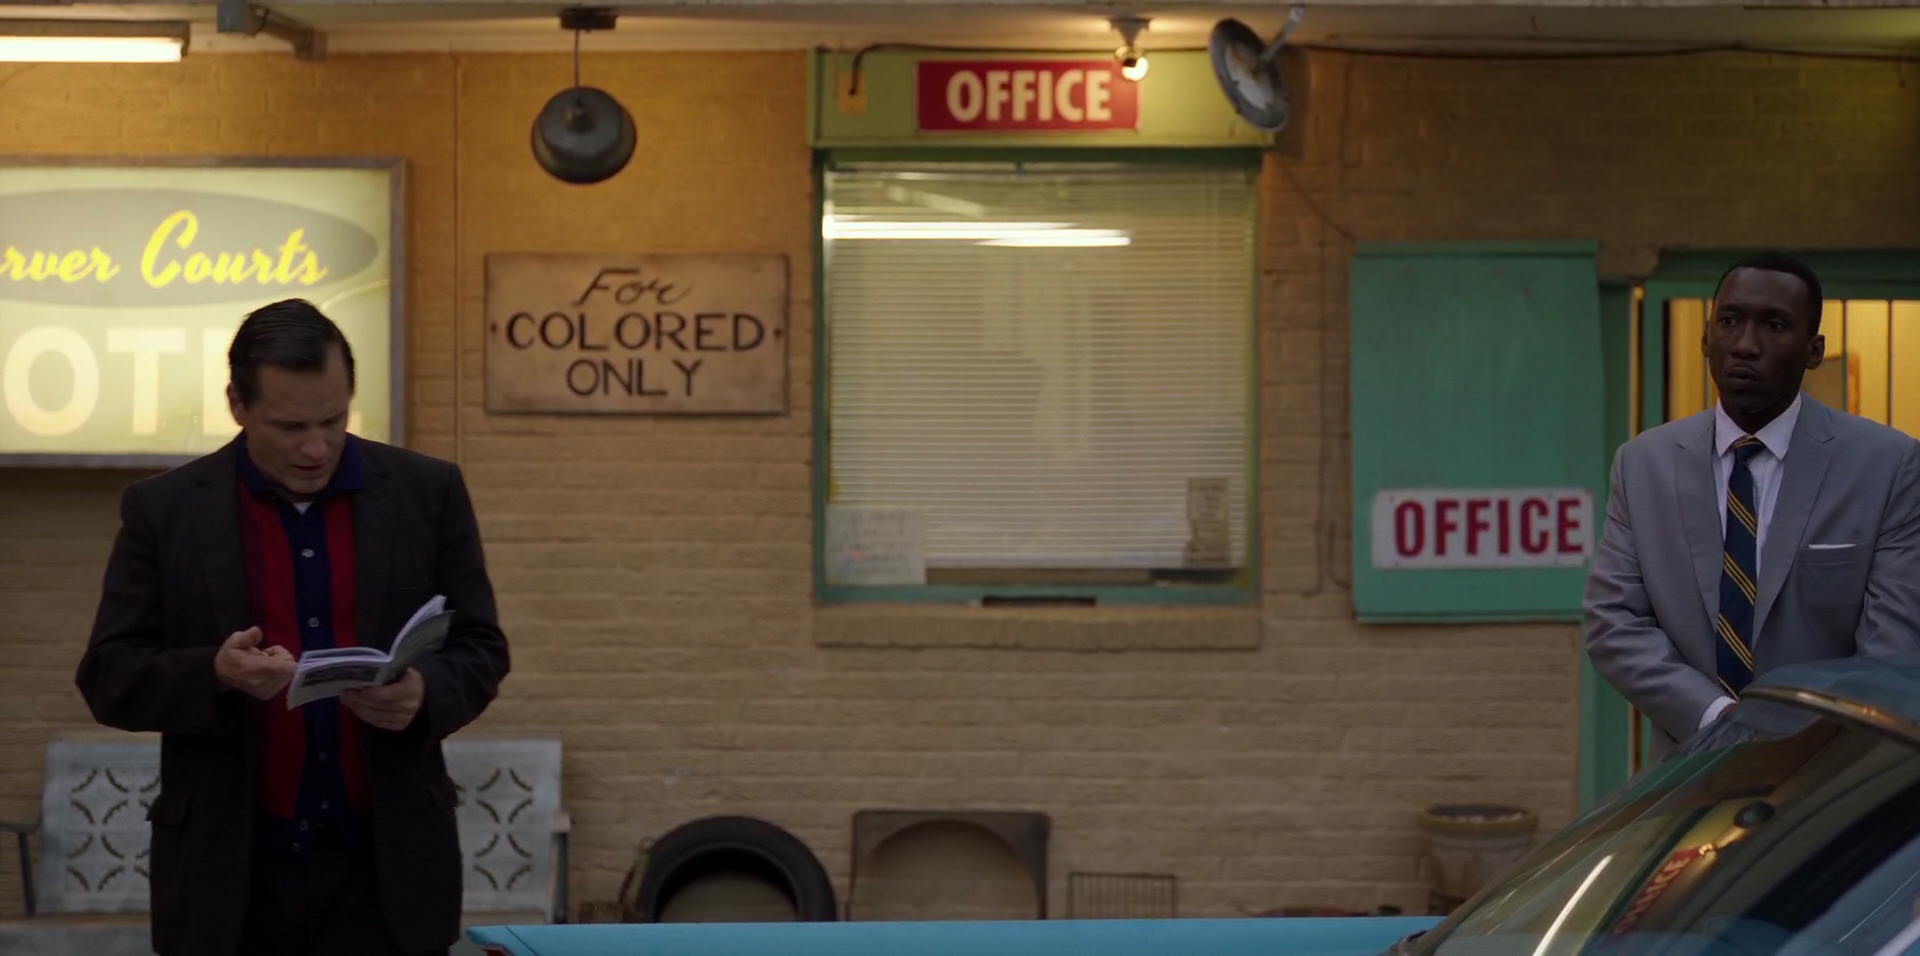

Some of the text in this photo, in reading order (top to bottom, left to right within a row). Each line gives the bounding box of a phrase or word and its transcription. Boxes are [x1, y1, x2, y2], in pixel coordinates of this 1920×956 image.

[946, 70, 1113, 123] OFFICE
[0, 210, 328, 289] rver Courts
[573, 268, 693, 306] For
[506, 312, 765, 351] COLORED
[566, 357, 702, 397] ONLY
[1395, 497, 1584, 557] OFFICE
